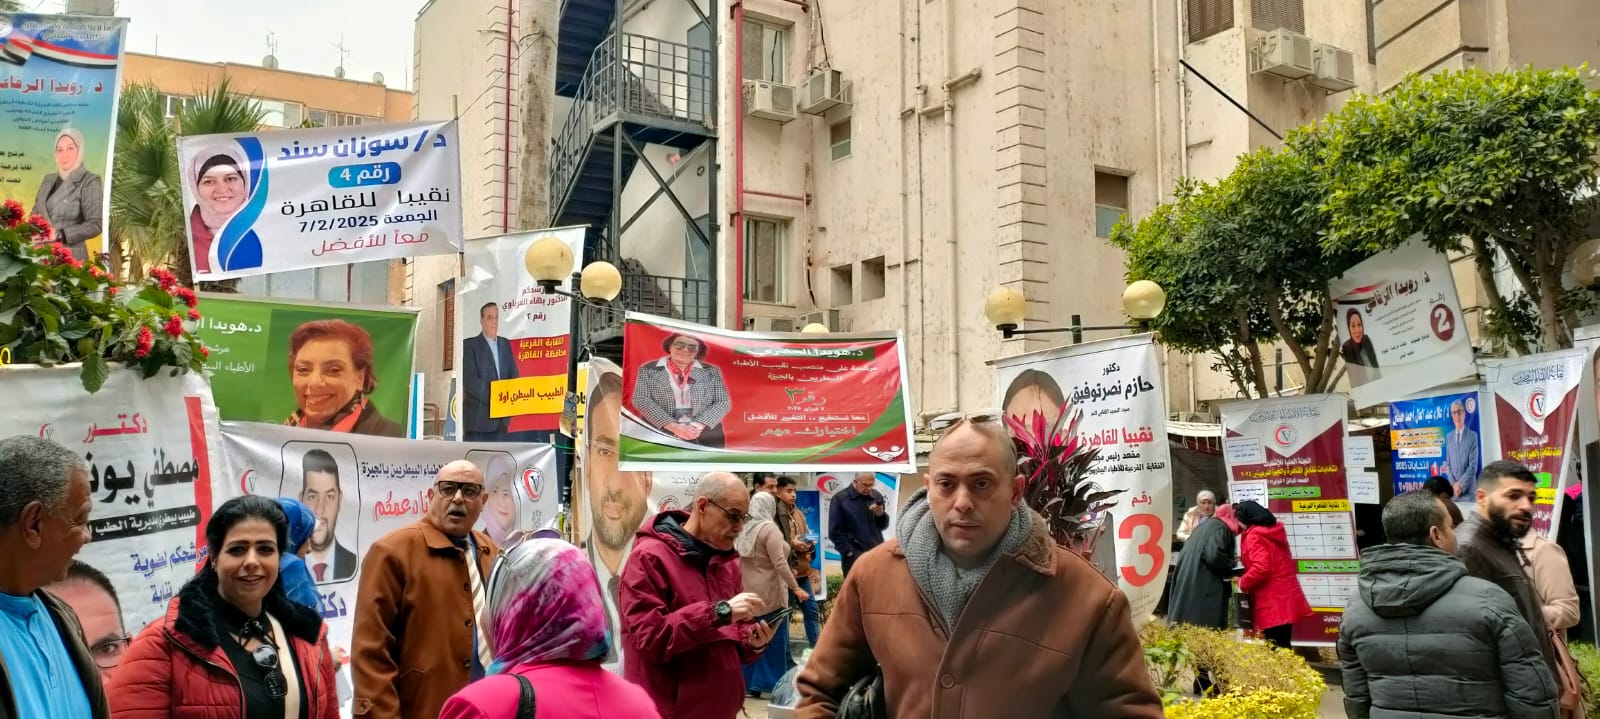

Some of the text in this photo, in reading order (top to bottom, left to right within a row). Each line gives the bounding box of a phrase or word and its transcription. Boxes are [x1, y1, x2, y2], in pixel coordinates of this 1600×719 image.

[277, 141, 327, 161] سند
[333, 136, 409, 158] سوزان
[340, 164, 390, 184] رقم 4
[281, 187, 450, 218] نقيبا للقاهرة
[299, 209, 438, 232] الجمعة 7/2/2025
[312, 234, 387, 256] للأفضل
[1395, 279, 1418, 296] رويدا
[533, 312, 546, 322] رقم
[1434, 306, 1451, 333] 2
[520, 338, 543, 349] الفرعية
[518, 351, 542, 362] القاهرة
[225, 361, 255, 373] الأطباء
[792, 363, 824, 371] منصب
[1103, 362, 1120, 376] دكتور
[768, 373, 794, 381] بالجيزة
[537, 386, 563, 400] الطبيب
[1125, 375, 1154, 400] حازم
[510, 388, 535, 405] البيطري
[785, 387, 826, 406] رقم ٣
[747, 413, 777, 421] للأفضل
[818, 413, 849, 422] نستطيع
[851, 413, 866, 421] معا
[82, 412, 147, 444] دكتور
[760, 427, 790, 436] مهم
[1081, 426, 1153, 451] نقيبا للقاهرة
[361, 462, 389, 479] بالجيزة
[391, 464, 422, 479] البيطريين
[1125, 464, 1144, 473] الفرعية
[1147, 462, 1165, 472] النقابة
[86, 451, 140, 504] يون
[1131, 491, 1152, 507] رقم
[95, 519, 127, 536] الطب
[170, 541, 207, 570] مرشحكم
[1118, 513, 1165, 587] 3
